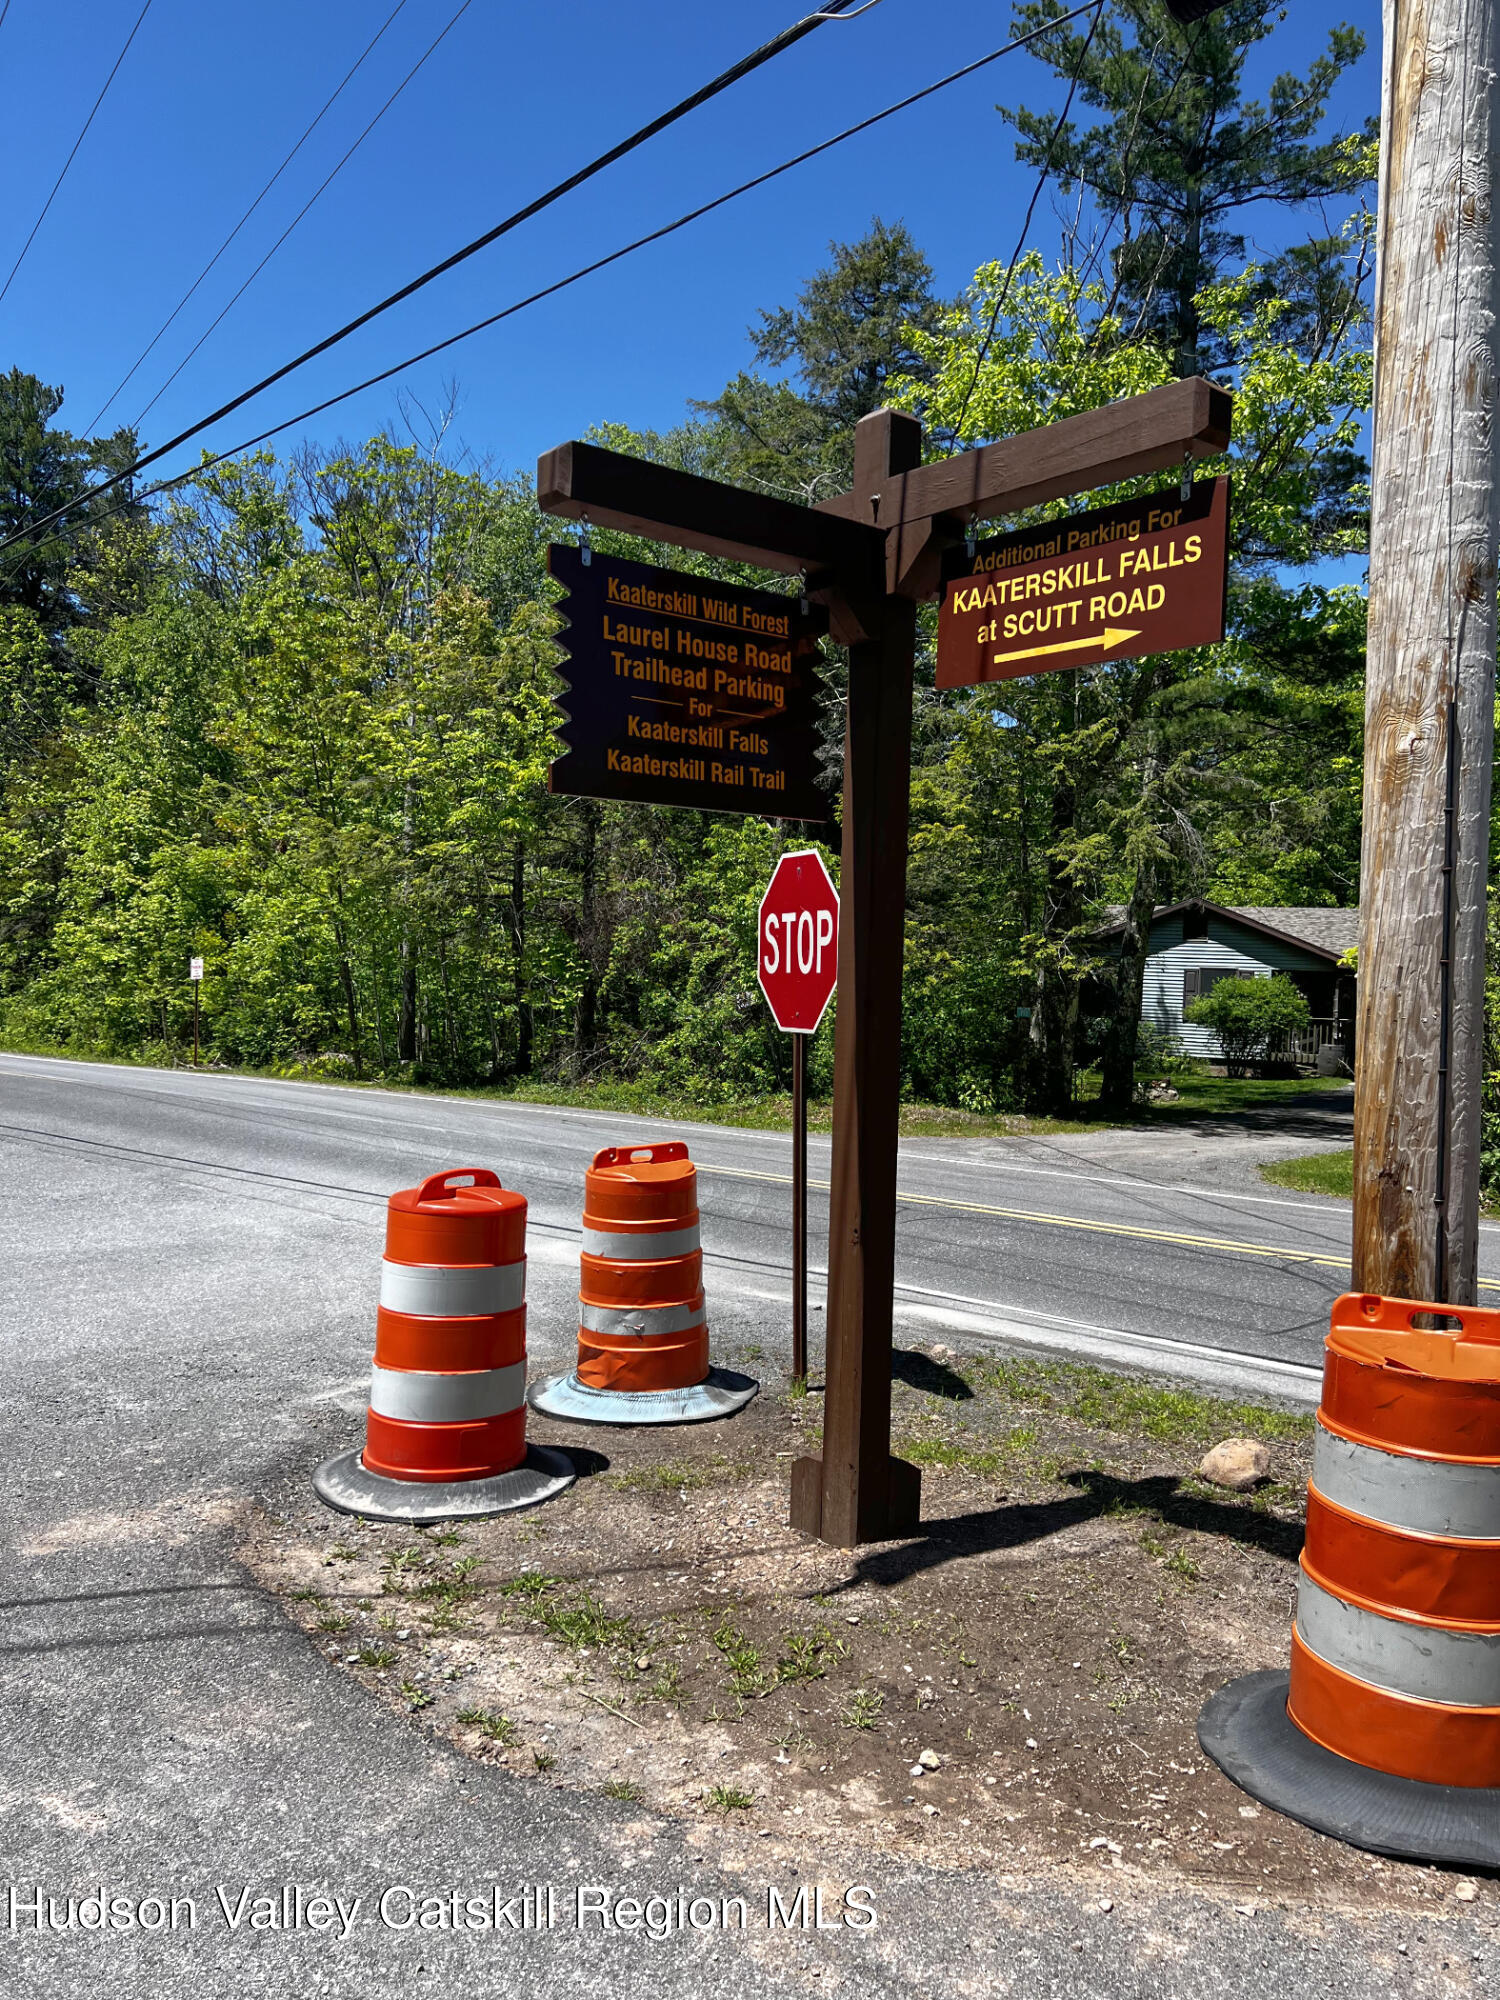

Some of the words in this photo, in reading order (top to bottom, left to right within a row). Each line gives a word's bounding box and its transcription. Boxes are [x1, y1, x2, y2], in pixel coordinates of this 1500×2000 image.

[973, 537, 1060, 575] Additional
[1067, 519, 1140, 551] Parking
[1148, 508, 1182, 532] For
[953, 557, 1111, 615] KAATERSKILL
[1119, 535, 1202, 578] FALLS
[608, 576, 697, 616] Kaaterskill
[702, 597, 738, 625] Wild
[742, 607, 789, 635] Forest
[977, 619, 997, 644] at
[1003, 600, 1083, 638] SCUTT
[1089, 584, 1166, 622] ROAD
[603, 615, 669, 651] Laurel
[677, 631, 738, 663] House
[745, 644, 792, 674] Road
[611, 651, 707, 690] Trailhead
[714, 670, 785, 708] Parking
[689, 698, 712, 717] For
[628, 715, 723, 749] Kaaterskill
[730, 731, 769, 755] Falls
[607, 748, 705, 781] Kaaterskill
[711, 765, 744, 786] Rail
[749, 767, 785, 790] Trail
[764, 910, 833, 974] STOP
